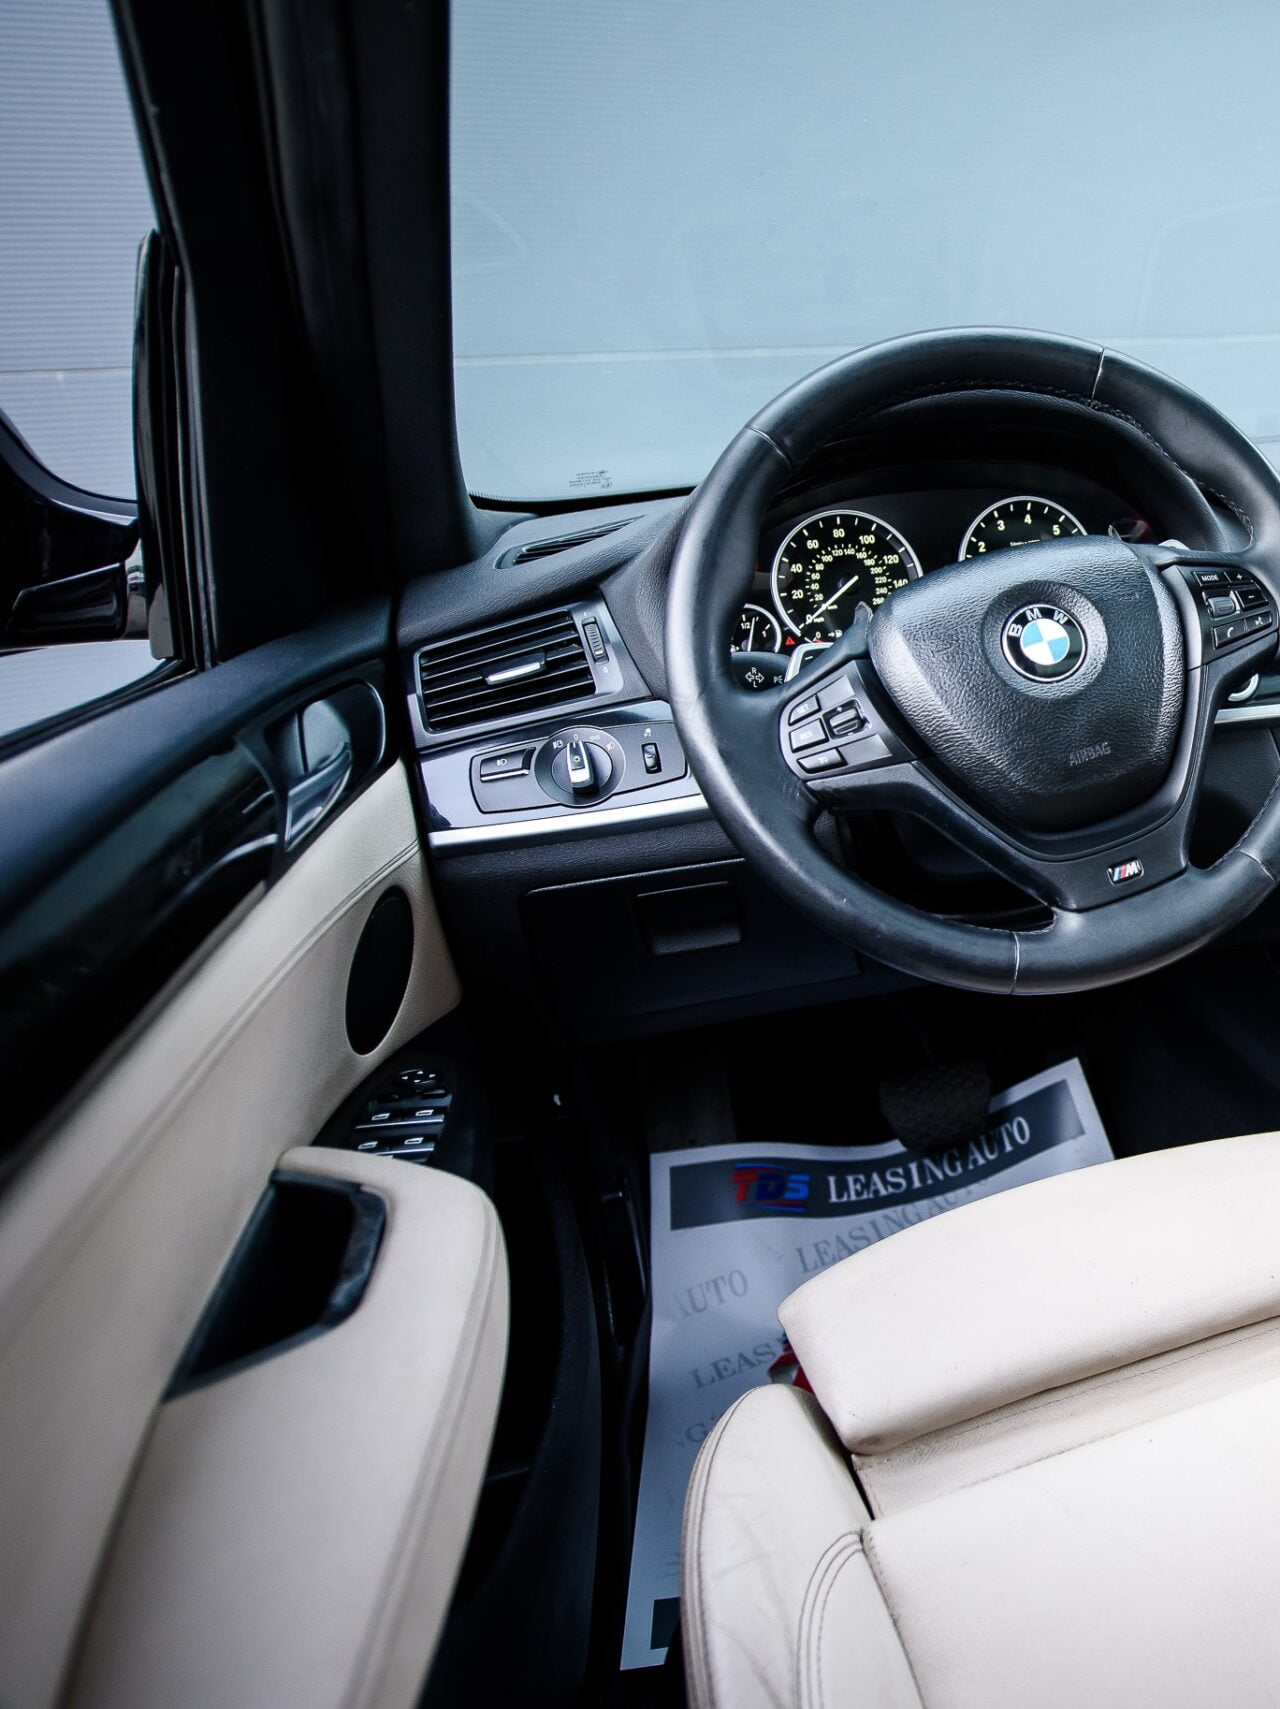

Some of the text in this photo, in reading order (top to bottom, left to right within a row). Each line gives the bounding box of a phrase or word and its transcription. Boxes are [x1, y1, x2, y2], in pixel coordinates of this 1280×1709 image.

[1024, 514, 1032, 524] 4
[996, 520, 1005, 531] 3
[1052, 525, 1060, 535] 5
[832, 529, 845, 538] 80
[806, 540, 819, 549] 60
[859, 535, 875, 544] 100
[977, 542, 986, 552] 2
[883, 554, 899, 564] 120
[790, 563, 803, 573] 40
[791, 589, 804, 599] 20
[1008, 607, 1068, 637] BMW
[751, 667, 757, 675] R
[1069, 742, 1111, 766] AIRBAG
[731, 1166, 811, 1204] TDS
